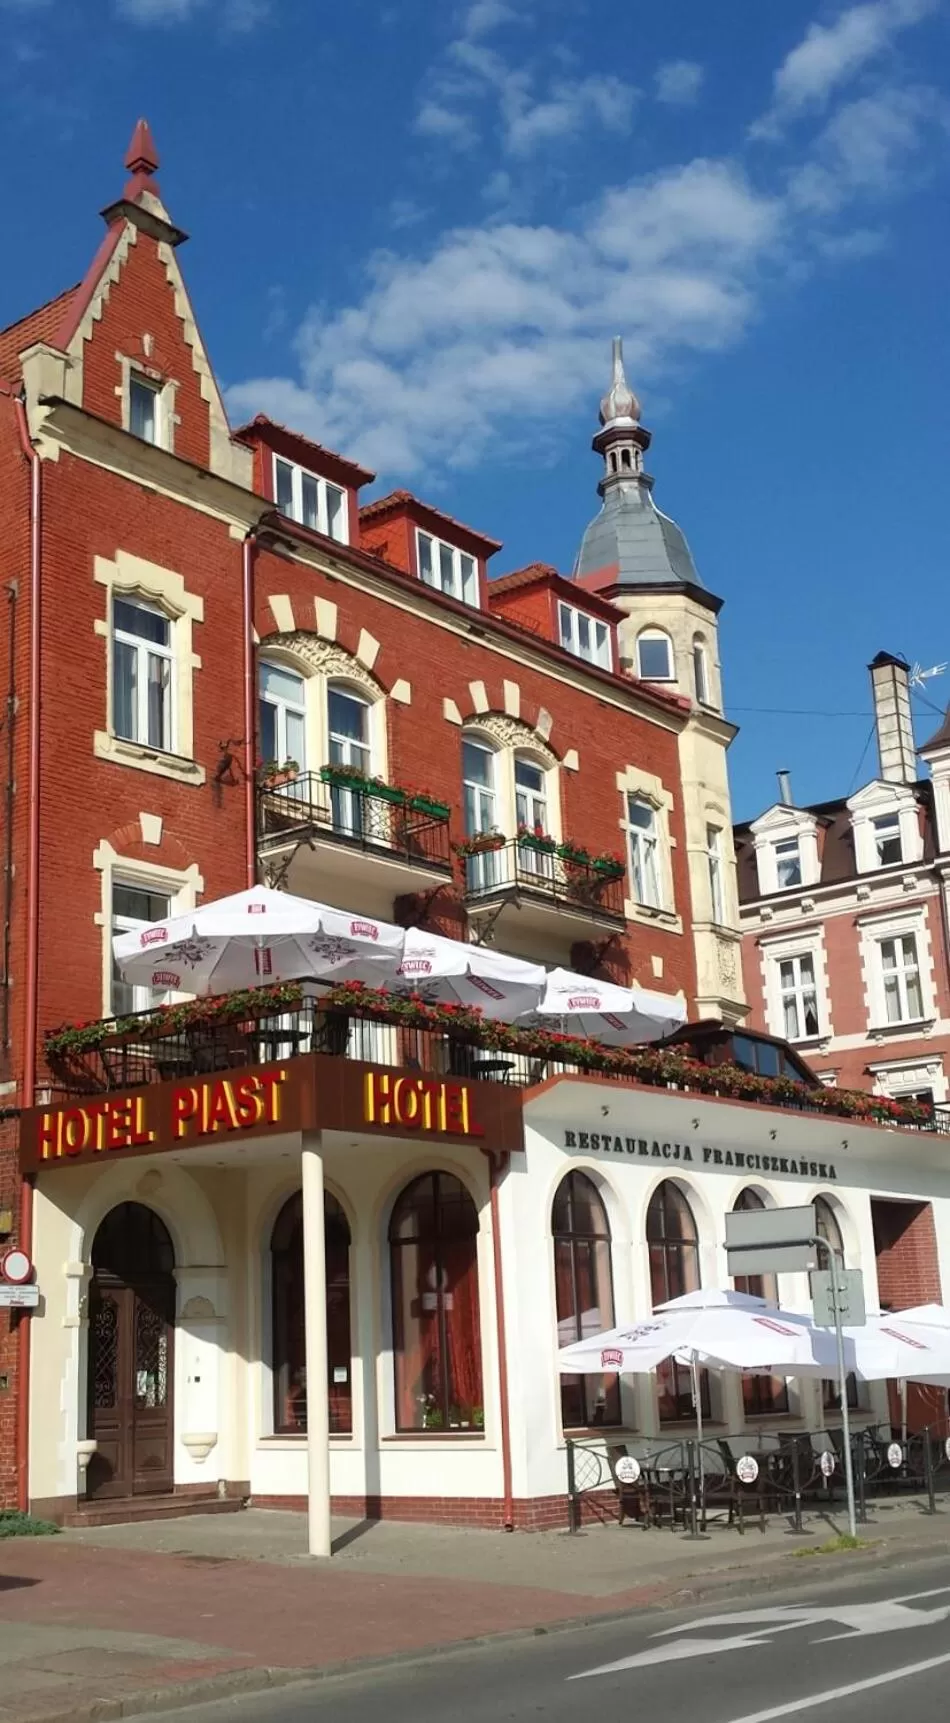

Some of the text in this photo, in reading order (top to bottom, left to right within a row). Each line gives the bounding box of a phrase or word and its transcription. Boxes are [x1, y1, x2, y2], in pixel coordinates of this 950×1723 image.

[38, 1070, 287, 1161] HOTEL PIAST
[364, 1072, 485, 1136] HOTEL
[564, 1131, 837, 1179] RESTAURACJA FRANCISZKAŃSKA
